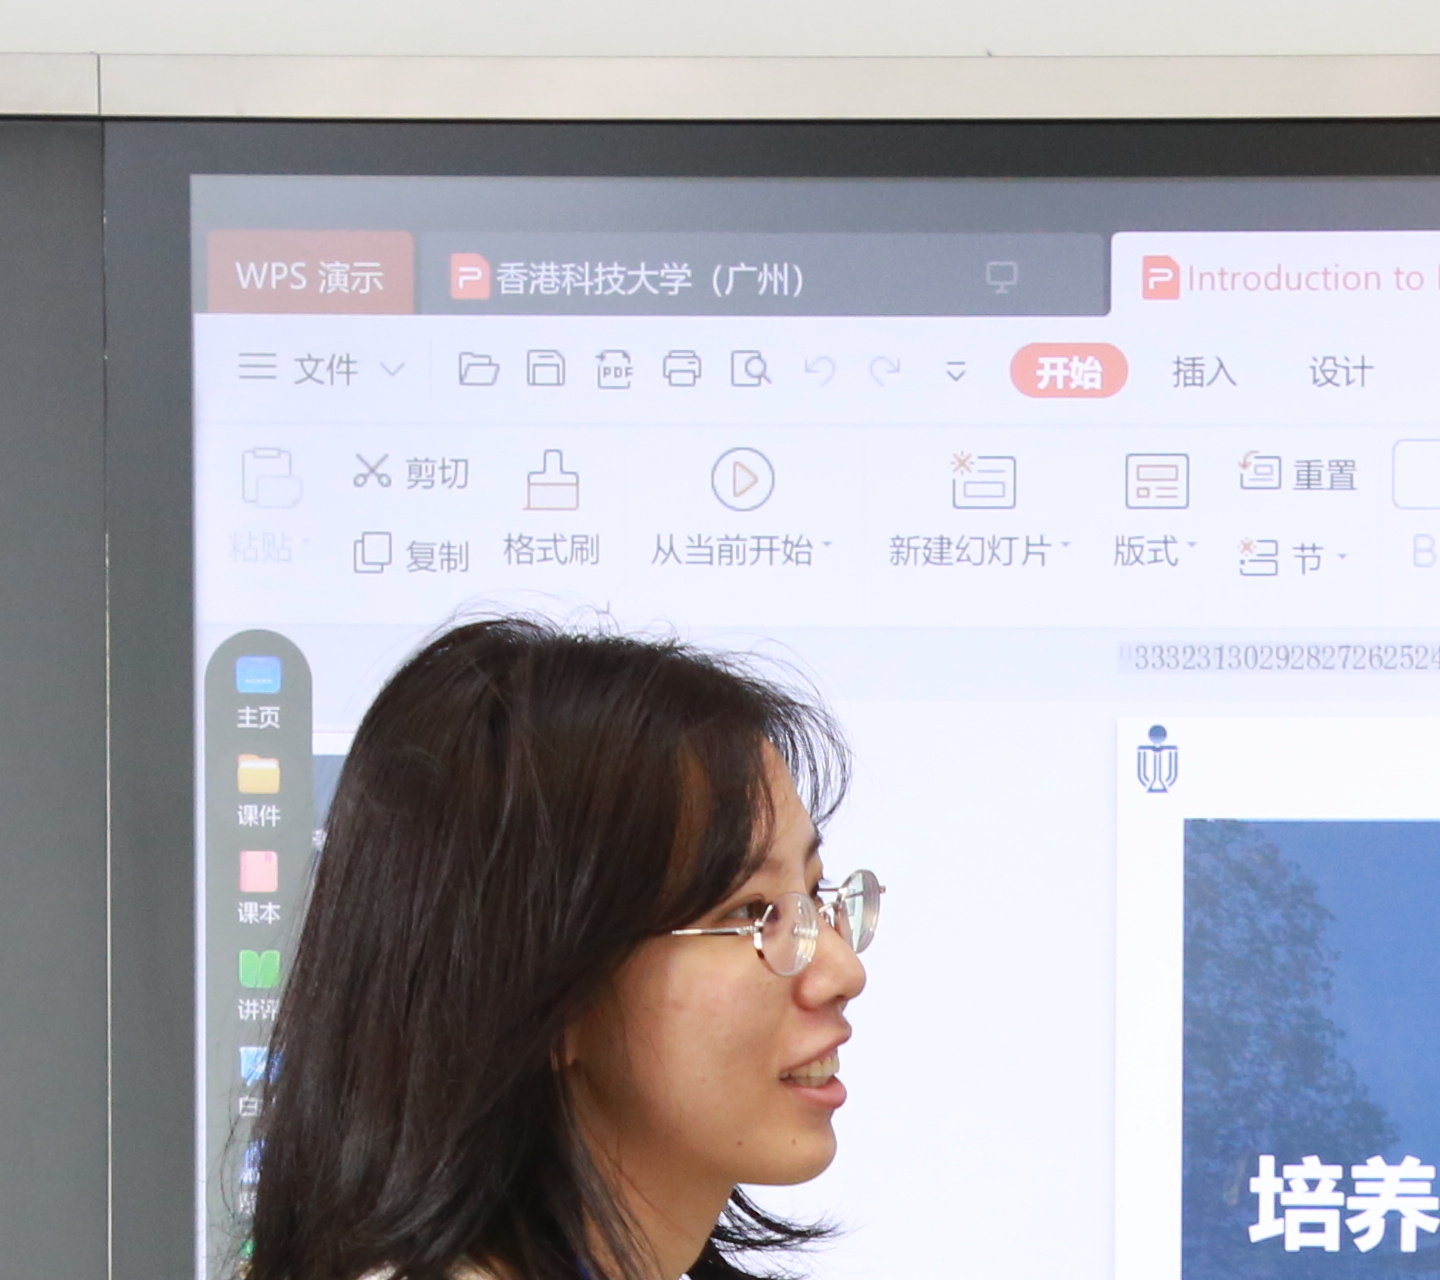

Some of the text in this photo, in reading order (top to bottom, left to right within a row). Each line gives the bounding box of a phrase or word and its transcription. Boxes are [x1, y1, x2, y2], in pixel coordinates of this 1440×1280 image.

[235, 260, 384, 295] WPS 演示
[496, 261, 805, 298] 香港科技大学（广州）
[1187, 262, 1383, 294] Introduction
[1392, 265, 1426, 293] to
[293, 353, 358, 387] 文件
[1035, 356, 1103, 390] 开始
[1172, 355, 1238, 389] 插入
[1308, 355, 1375, 389] 设计
[405, 457, 470, 491] 剪切
[1292, 459, 1358, 492] 重置
[405, 540, 470, 574] 复制
[503, 533, 601, 568] 格式刷
[650, 533, 815, 568] 从当前开始
[888, 533, 1052, 568] 新建幻灯片
[1113, 534, 1180, 568] 版式
[1292, 542, 1324, 575] 节
[237, 706, 281, 730] 主页
[237, 804, 281, 828] 课件
[237, 901, 281, 925] 课本
